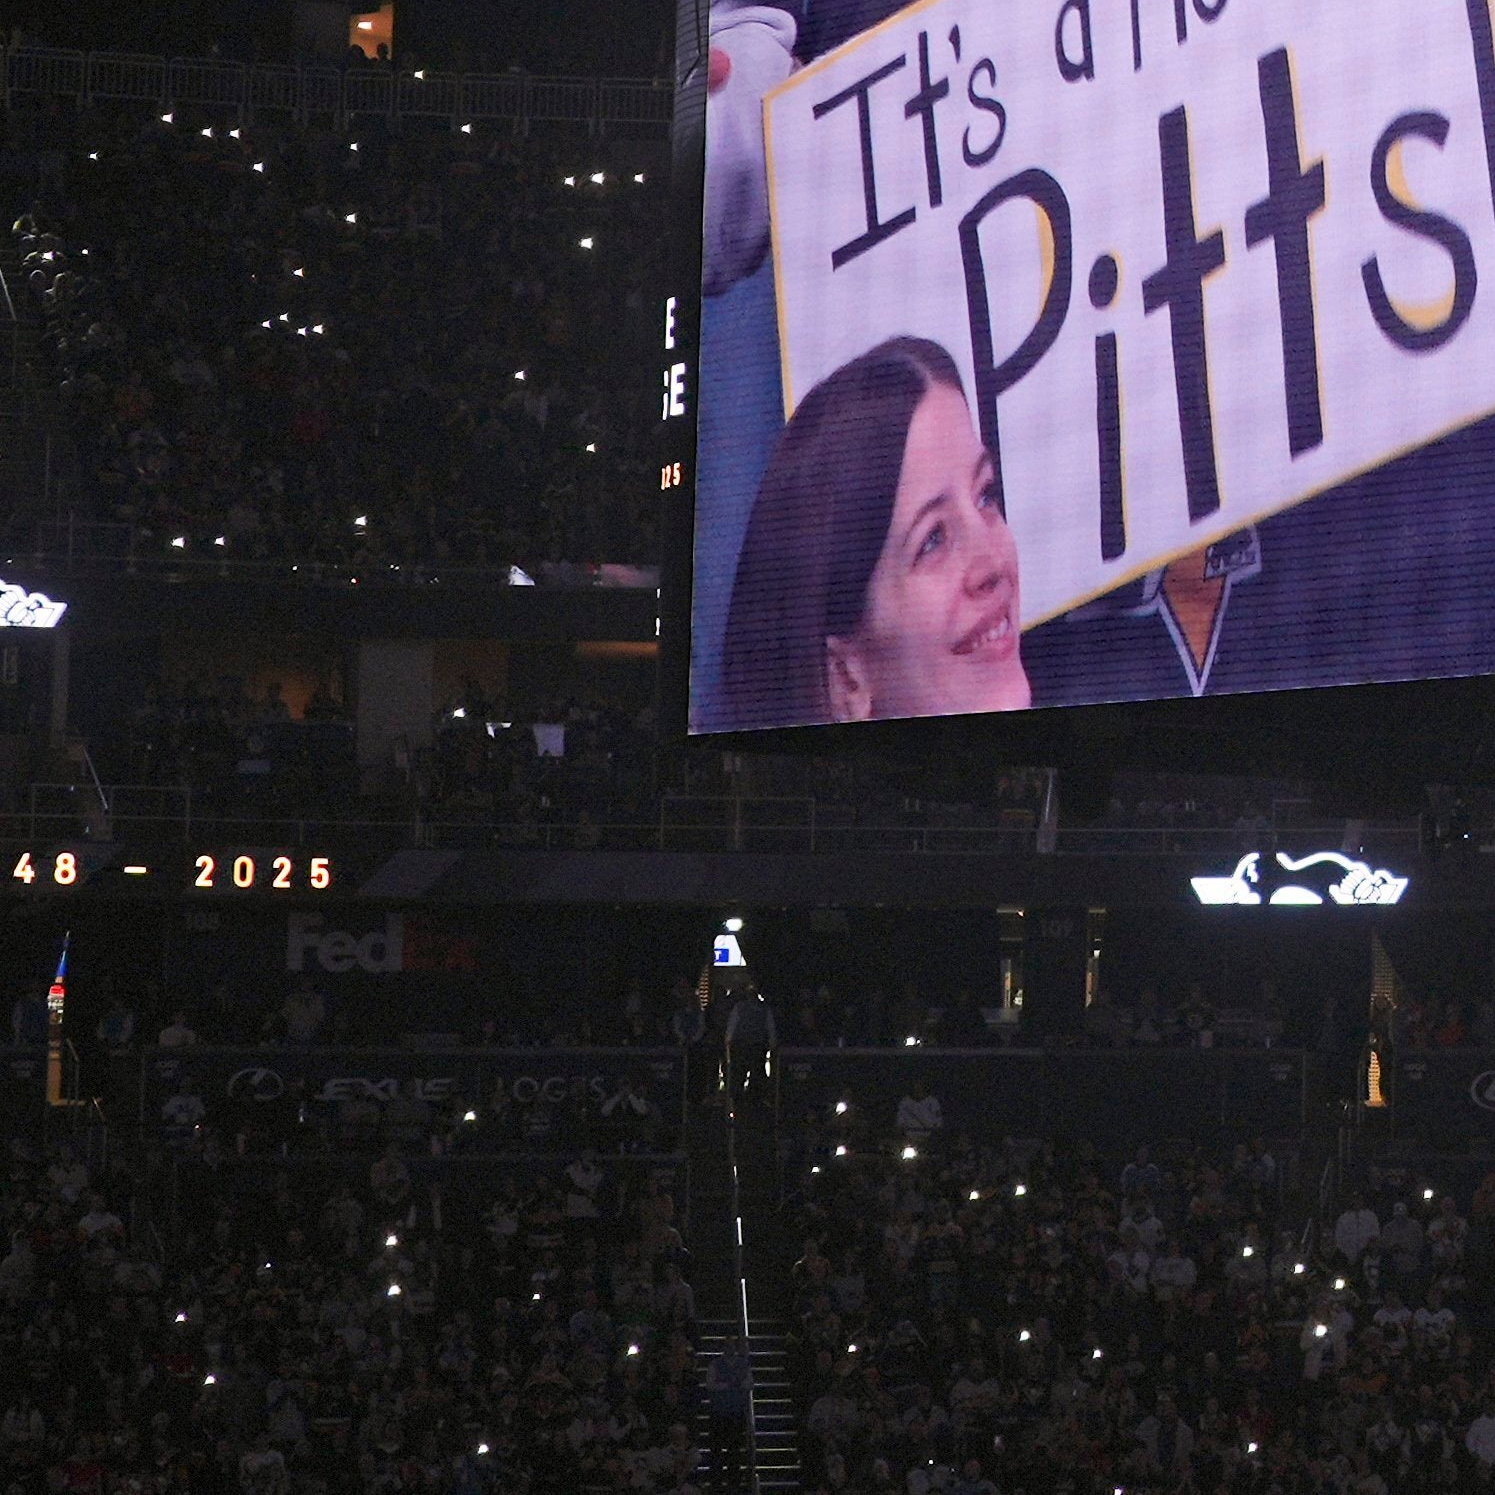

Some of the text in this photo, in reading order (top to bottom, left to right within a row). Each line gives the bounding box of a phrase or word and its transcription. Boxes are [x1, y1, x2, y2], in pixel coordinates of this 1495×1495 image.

[811, 24, 1007, 273] It's
[194, 855, 331, 889] 2025
[286, 911, 479, 973] FedEx
